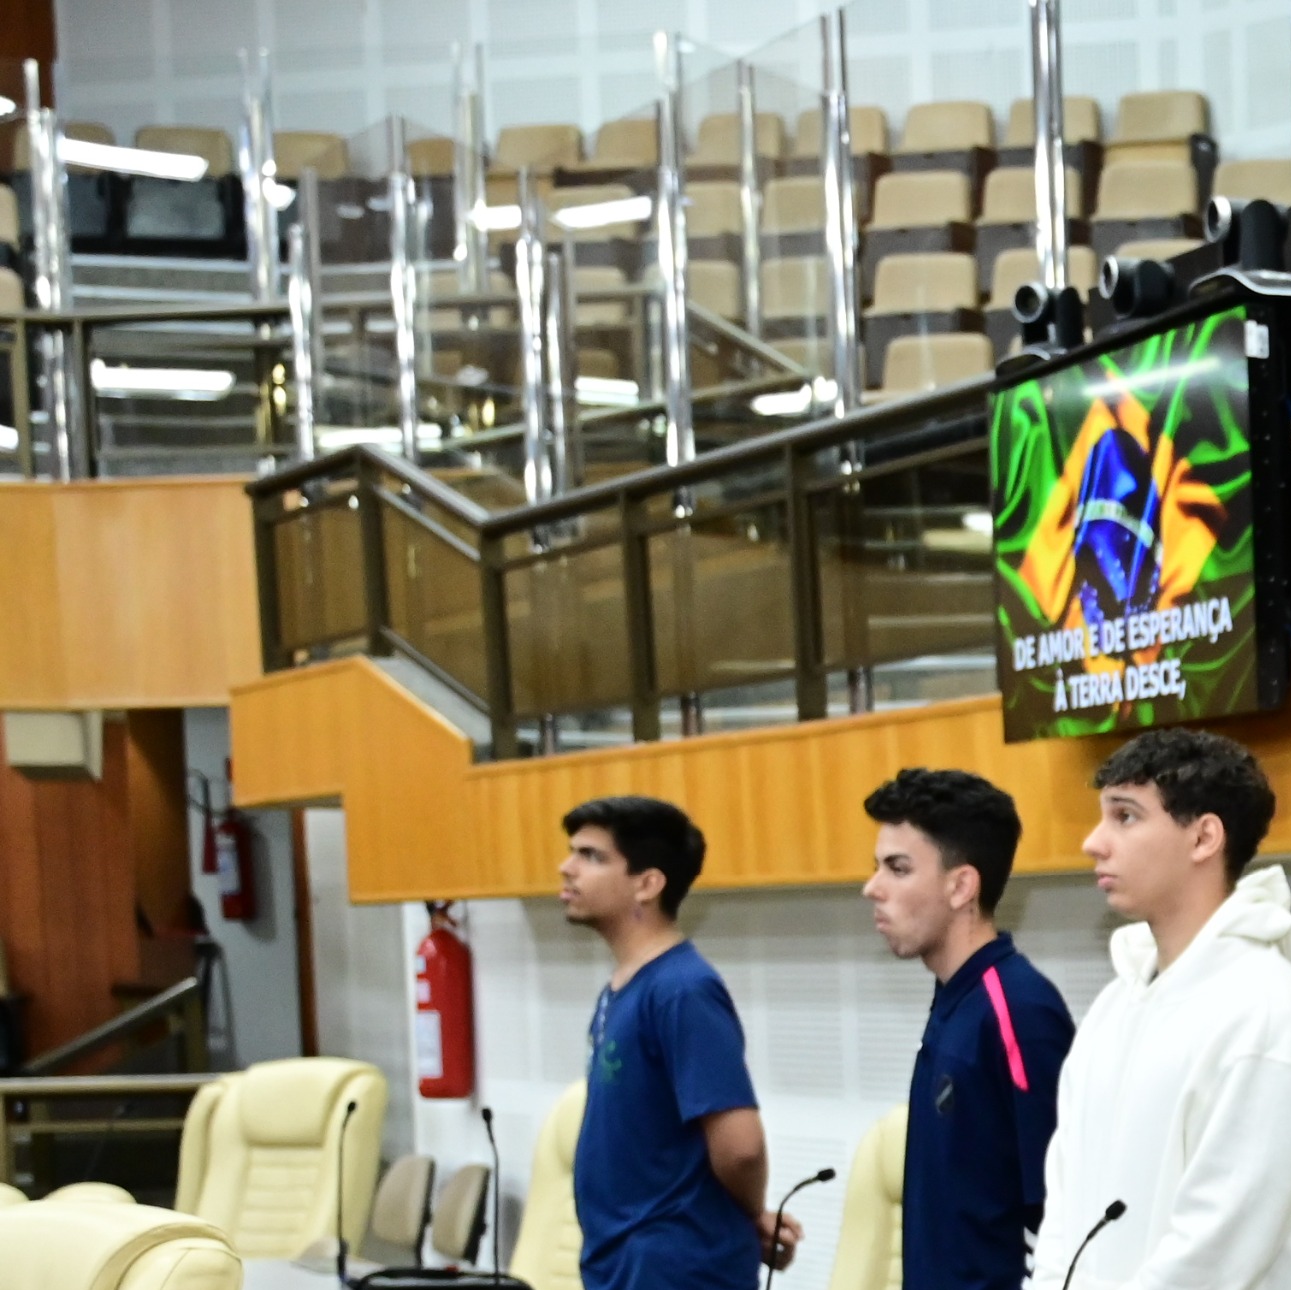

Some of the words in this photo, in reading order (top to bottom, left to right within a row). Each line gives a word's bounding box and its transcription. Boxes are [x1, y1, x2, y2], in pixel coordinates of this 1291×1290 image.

[1013, 635, 1036, 671] DE
[1038, 627, 1085, 666] AMOR
[1089, 624, 1100, 657] E
[1102, 618, 1125, 654] DE
[1127, 597, 1233, 650] ESPERANÇA
[1054, 667, 1068, 713] À
[1069, 669, 1124, 709] TERRA
[1125, 658, 1187, 701] DESCE,
